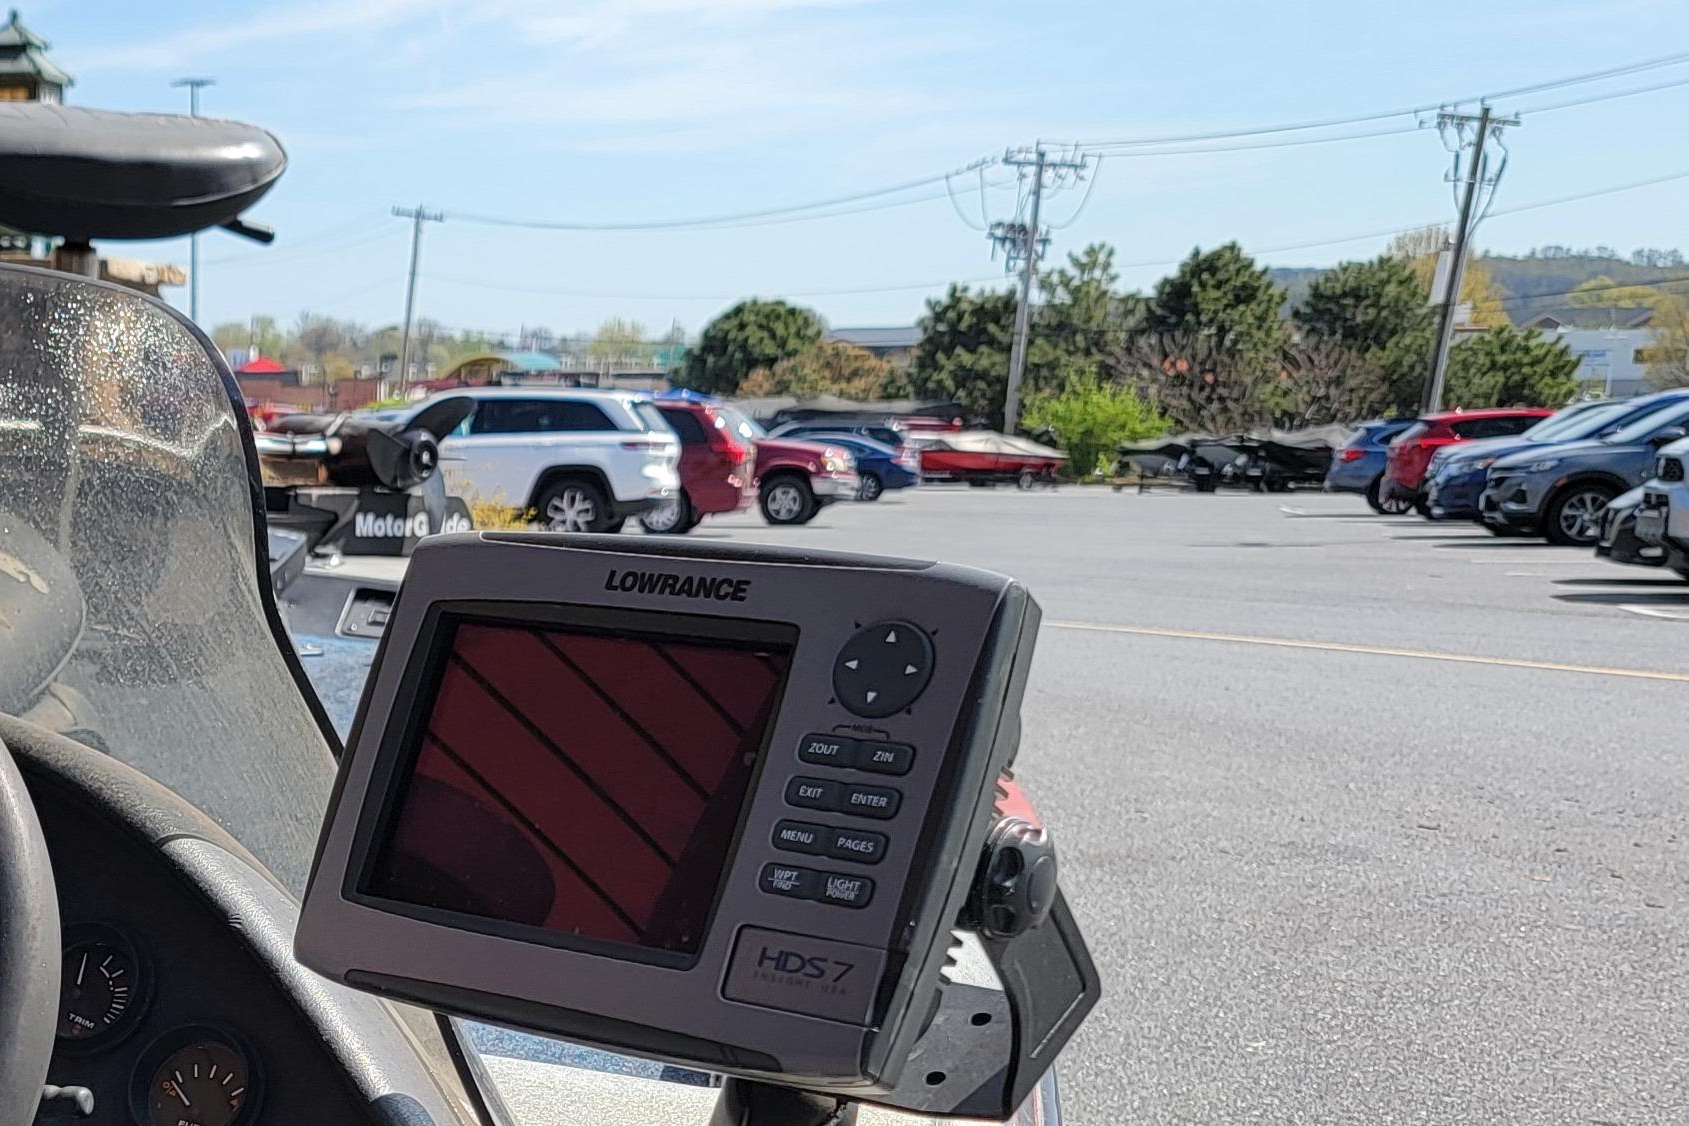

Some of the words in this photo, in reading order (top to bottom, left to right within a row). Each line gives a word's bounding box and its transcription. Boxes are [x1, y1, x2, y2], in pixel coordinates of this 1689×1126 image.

[604, 570, 752, 602] LOWRANCE
[808, 742, 839, 755] ZOUT
[872, 751, 895, 763] ZIN
[799, 785, 823, 798] EXIT
[851, 793, 888, 808] ENTER
[780, 829, 814, 844] MENU
[837, 838, 874, 853] PAGES
[774, 868, 799, 881] WPT
[827, 876, 861, 891] LIGHT
[826, 888, 856, 901] POWER
[68, 1012, 96, 1030] TRIM
